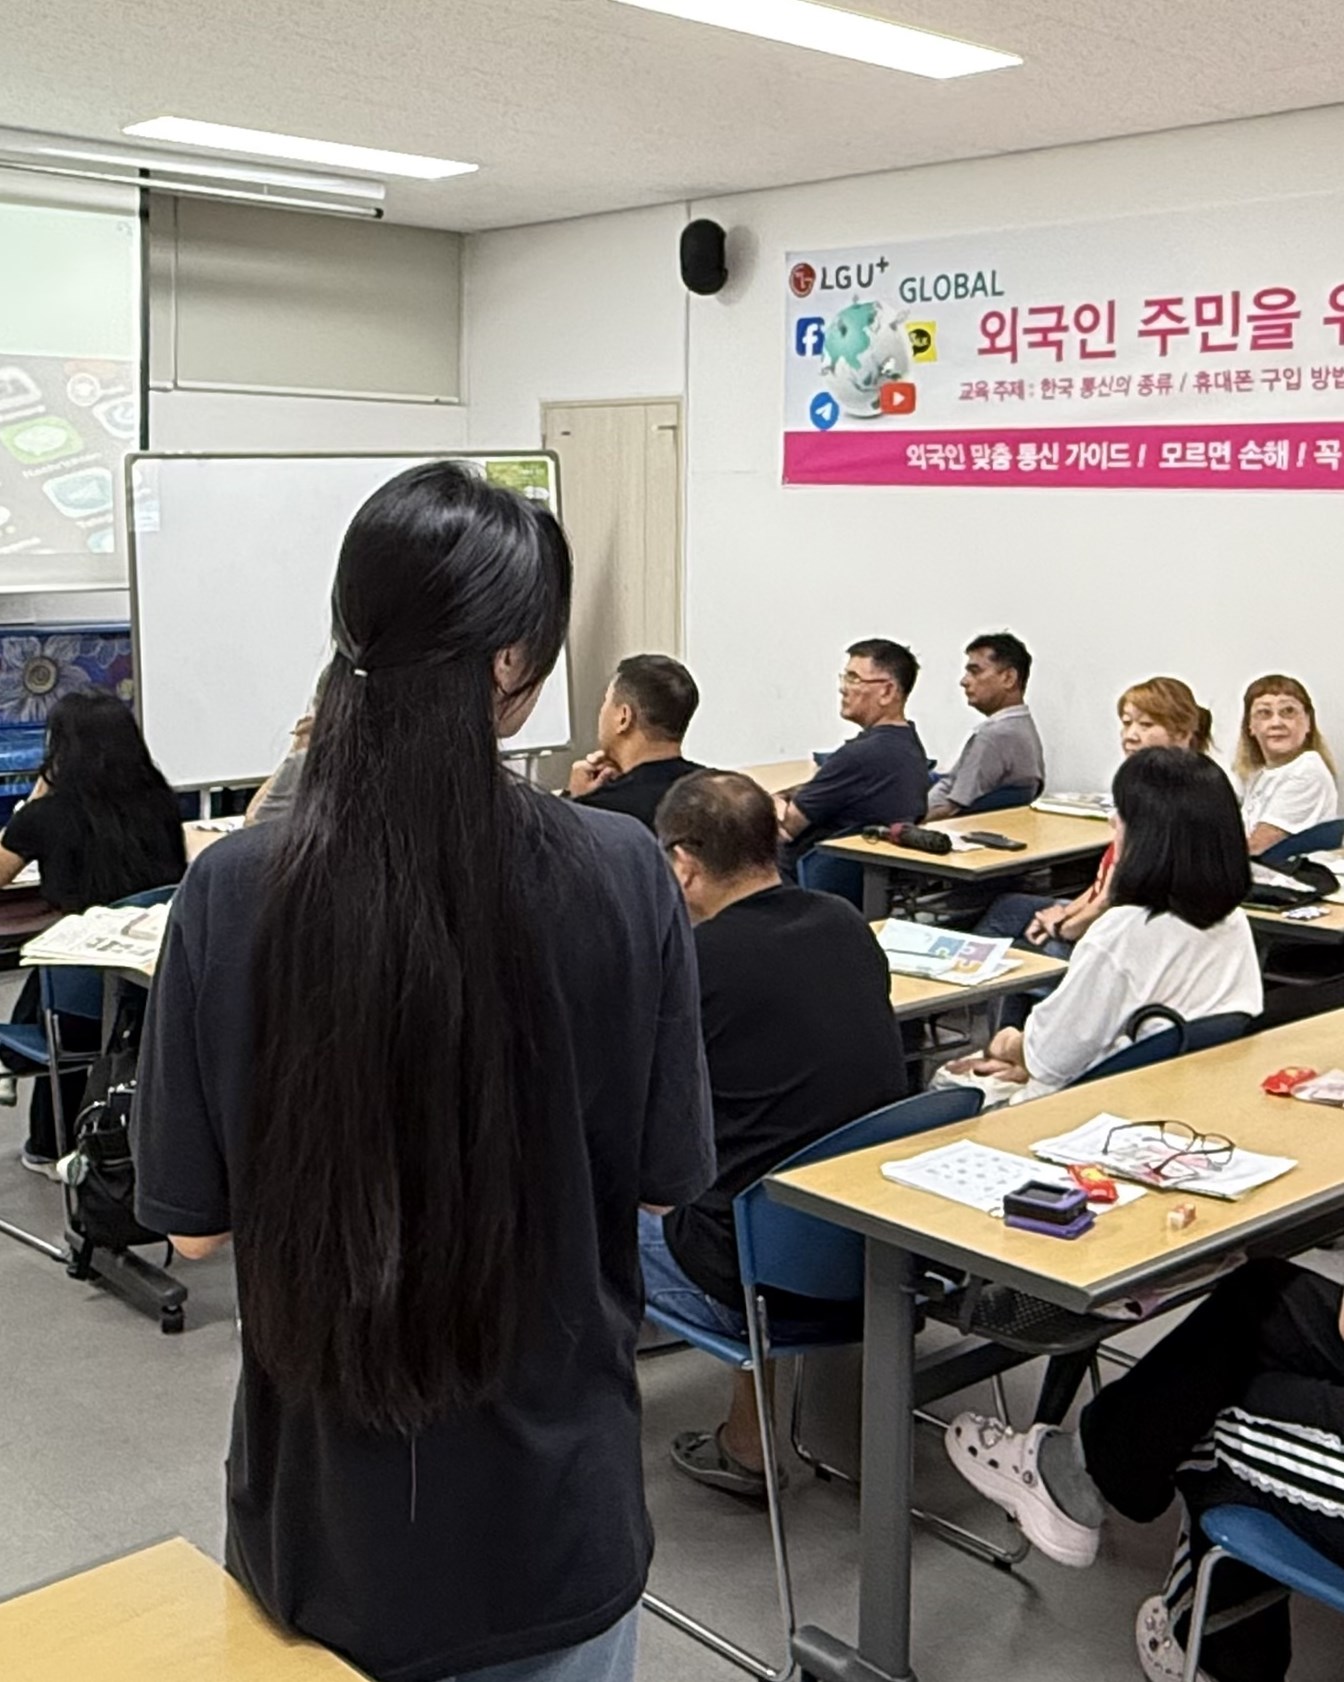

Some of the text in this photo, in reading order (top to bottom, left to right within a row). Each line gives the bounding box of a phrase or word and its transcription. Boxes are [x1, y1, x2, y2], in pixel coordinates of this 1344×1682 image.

[898, 269, 1005, 304] GLOBAL
[976, 299, 1117, 364] 외국인
[1137, 286, 1302, 358] 주민을
[958, 381, 989, 401] 교육
[993, 379, 1025, 400] 주제
[1040, 377, 1074, 399] 한국
[1080, 374, 1132, 398] 통신의
[1137, 372, 1173, 396] 종류
[1192, 369, 1255, 393] 휴대폰
[1260, 366, 1303, 391] 구입
[905, 442, 966, 472] 외국인
[969, 441, 1013, 472] 맞춤
[1016, 441, 1060, 472] 통신
[1064, 441, 1132, 471] 가이드
[1158, 440, 1232, 471] 모르면
[1238, 439, 1290, 471] 손해
[1312, 438, 1343, 472] 꼭
